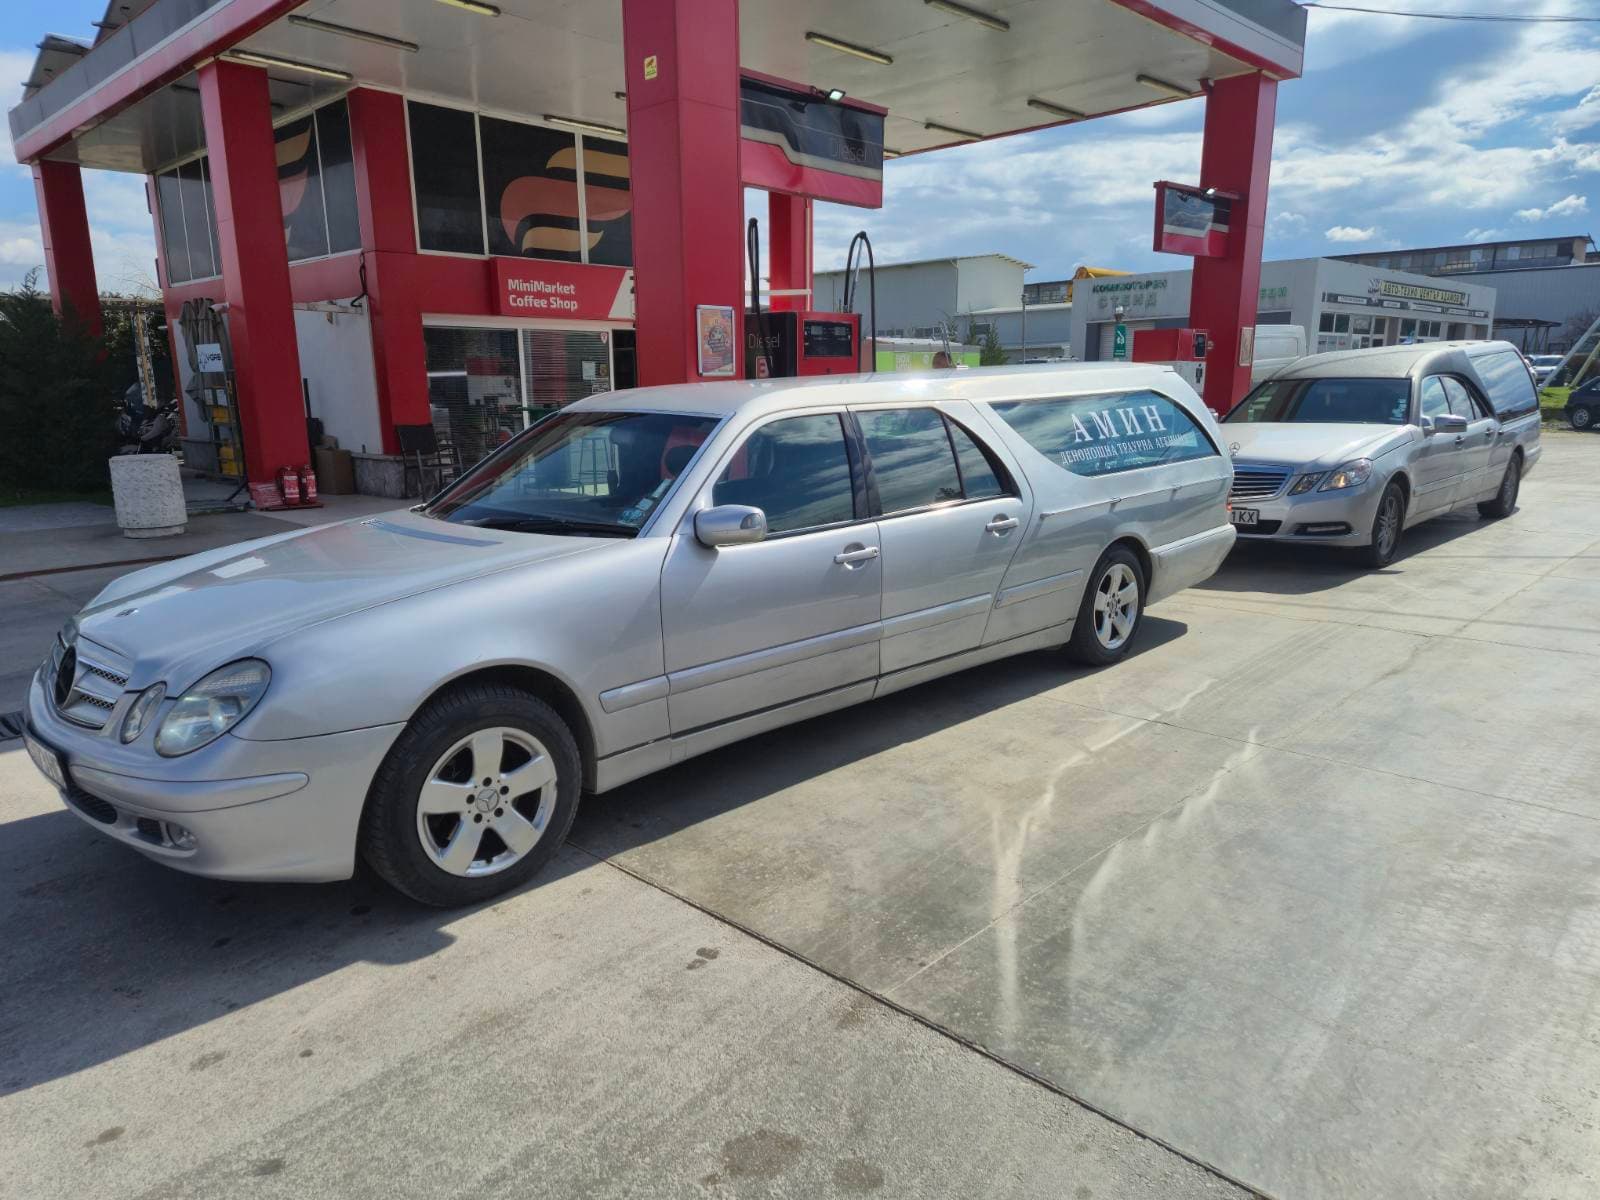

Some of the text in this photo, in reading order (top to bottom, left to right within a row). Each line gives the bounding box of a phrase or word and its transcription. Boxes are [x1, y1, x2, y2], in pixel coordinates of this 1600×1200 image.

[508, 279, 576, 295] MiniMarket
[509, 295, 578, 312] Coffee Shop
[1071, 405, 1167, 443] АМИН
